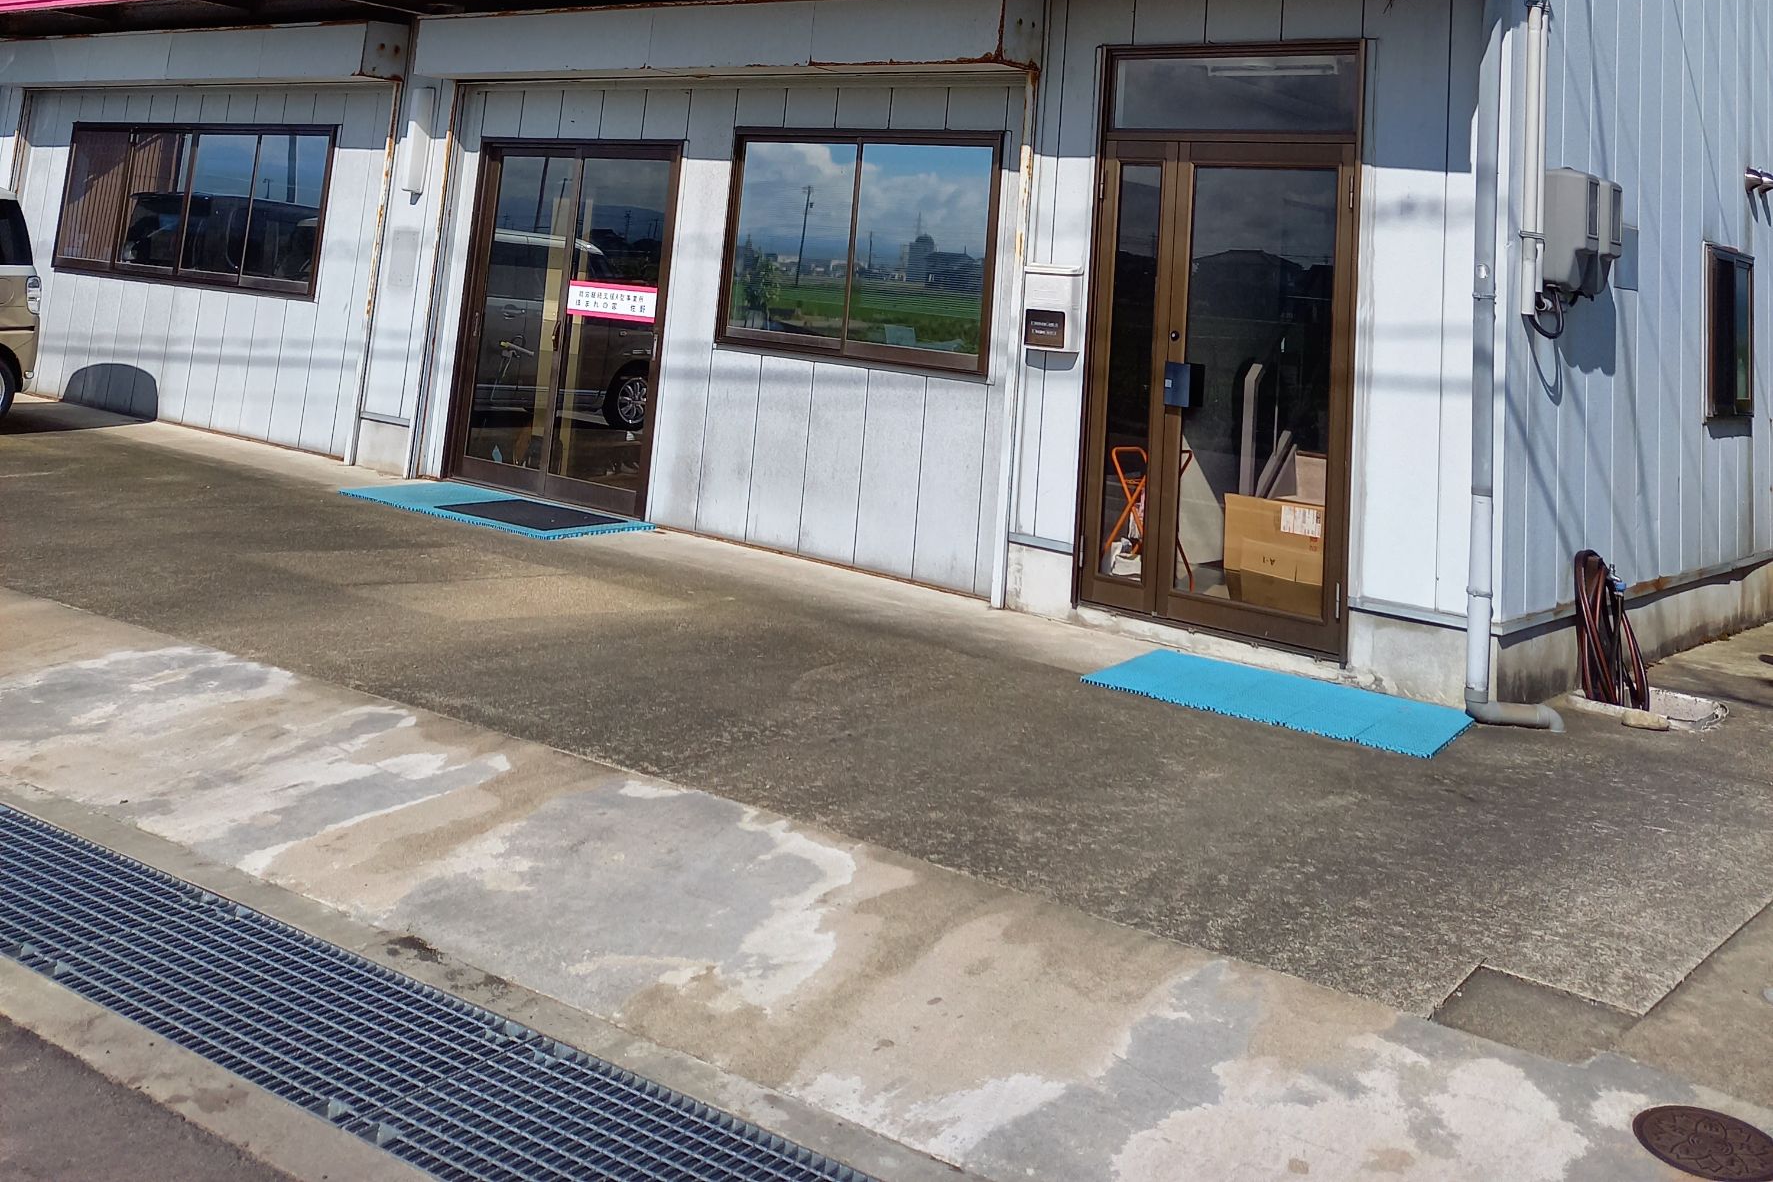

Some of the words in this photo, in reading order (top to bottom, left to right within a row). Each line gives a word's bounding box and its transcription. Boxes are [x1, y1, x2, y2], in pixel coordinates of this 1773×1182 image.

[575, 299, 618, 311] ほまれの家
[630, 304, 646, 314] 佐野
